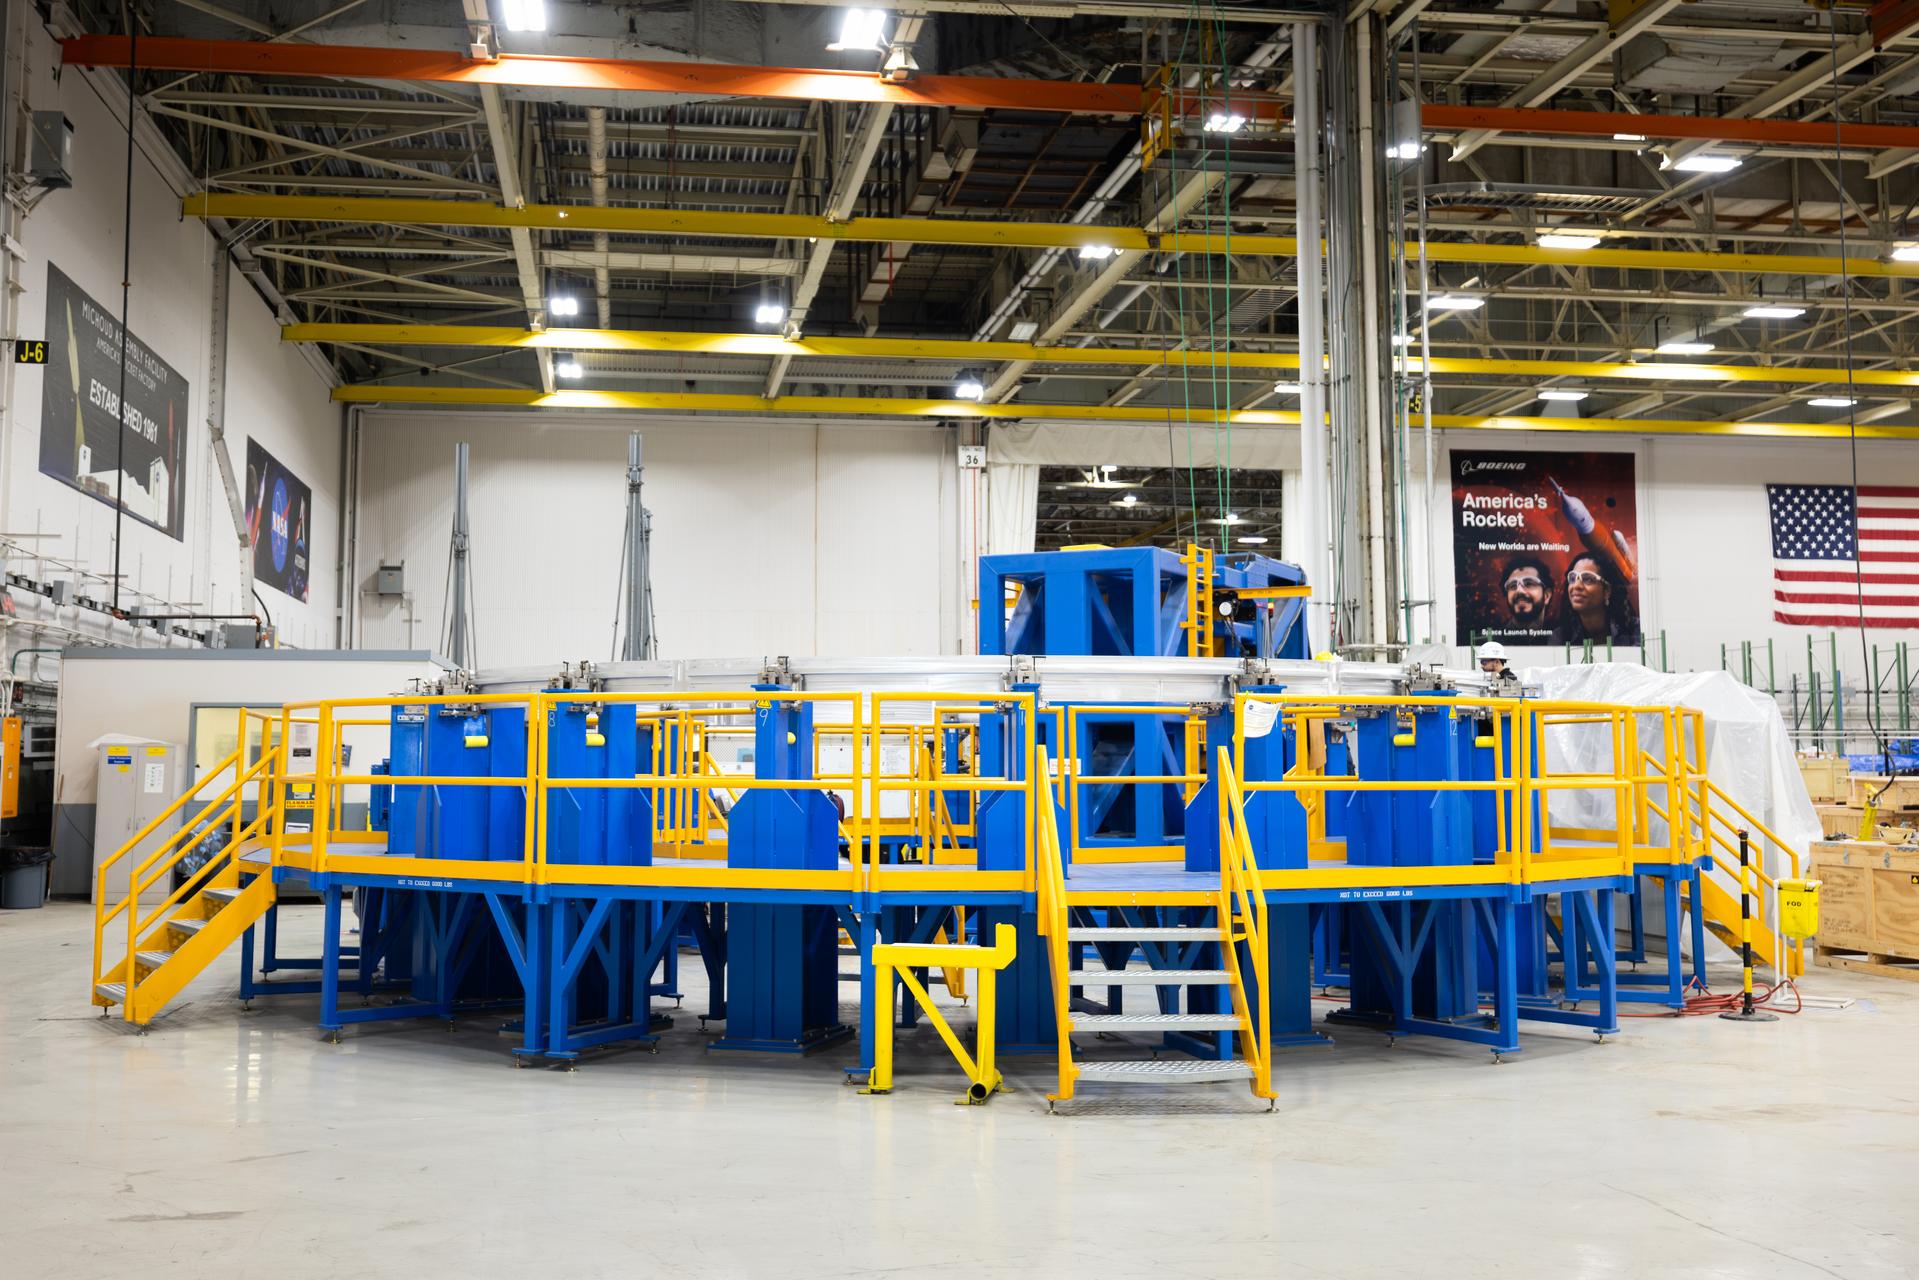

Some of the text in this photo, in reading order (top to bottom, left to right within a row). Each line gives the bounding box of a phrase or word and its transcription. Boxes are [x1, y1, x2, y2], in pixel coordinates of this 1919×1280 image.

[82, 300, 168, 384] MICHOUD ASEMBLY FACILITY
[20, 341, 43, 363] J-6
[123, 358, 138, 379] OCKET
[138, 370, 157, 392] FACTORY
[89, 378, 158, 444] ESTABLSHED 1961
[966, 455, 979, 465] 36
[1477, 462, 1526, 470] BOEING
[1462, 492, 1548, 509] America's
[1462, 511, 1524, 527] Rocket
[1478, 542, 1497, 550] New
[1497, 542, 1526, 551] Worlds
[1540, 542, 1570, 552] Waiting
[1503, 628, 1528, 636] Launch
[1528, 628, 1553, 637] System
[759, 708, 769, 727] 9
